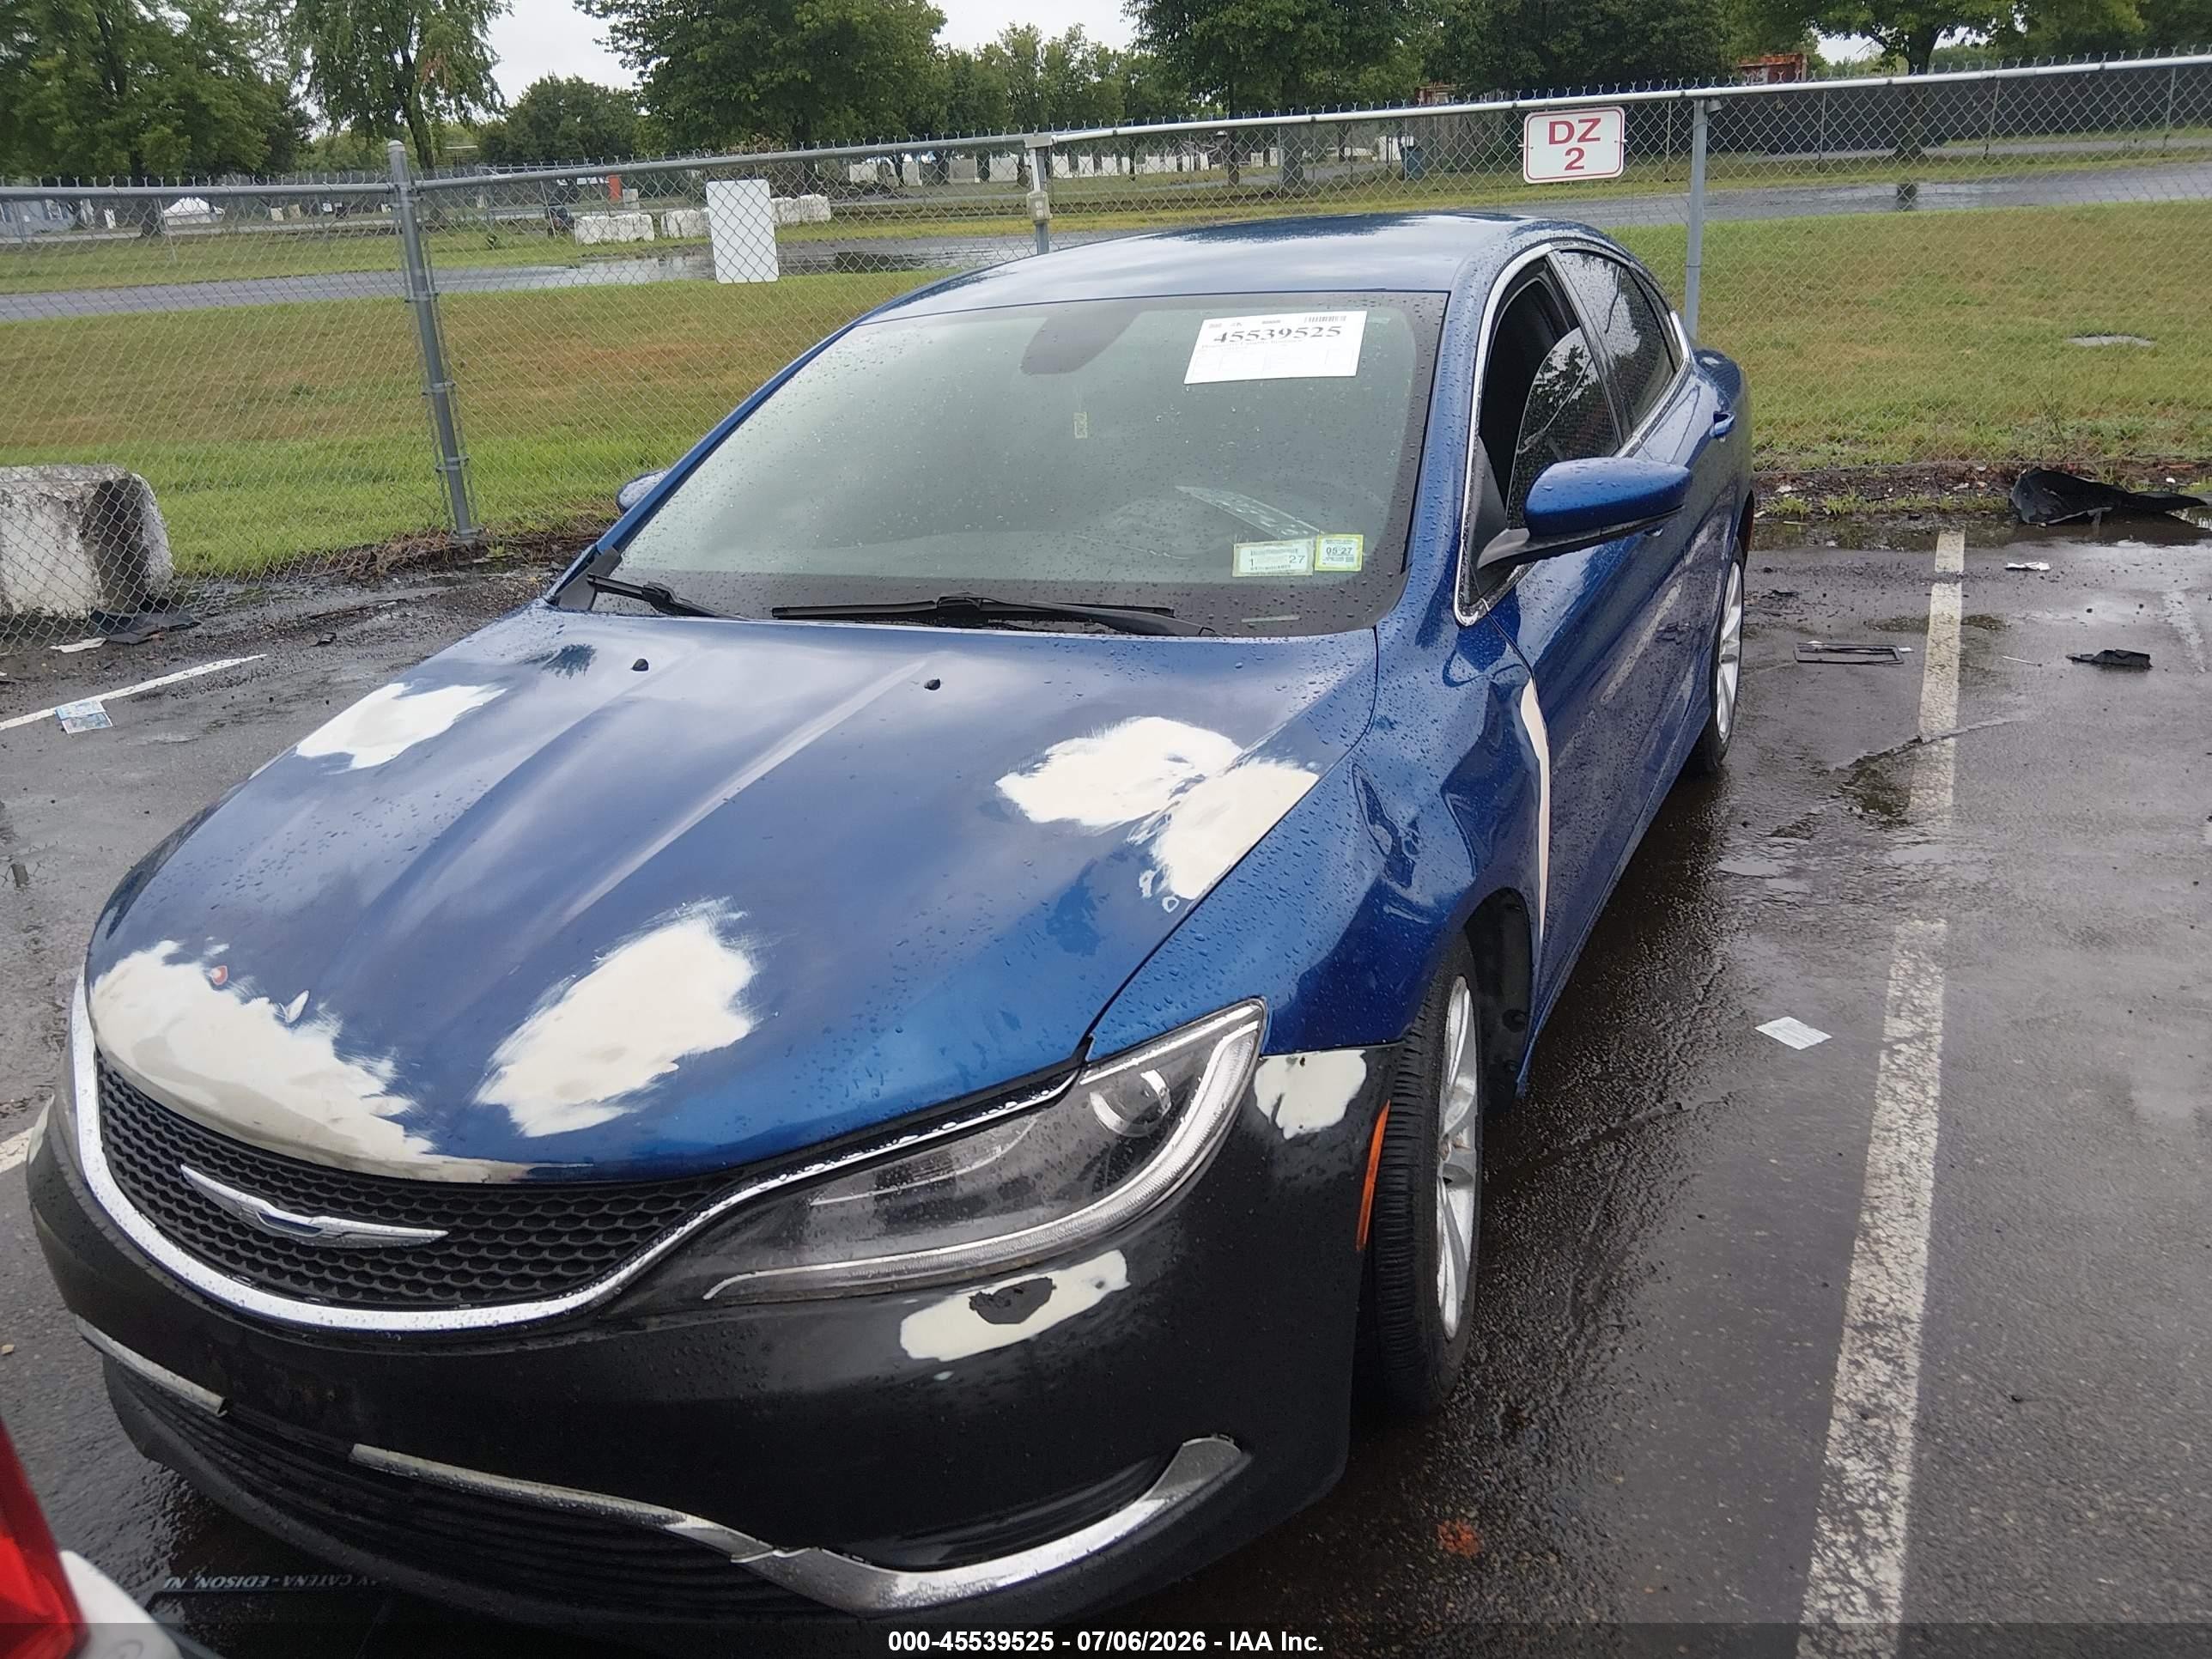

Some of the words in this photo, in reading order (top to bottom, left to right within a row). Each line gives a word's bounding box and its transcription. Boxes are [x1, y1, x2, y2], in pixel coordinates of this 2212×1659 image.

[1548, 118, 1601, 145] DZ
[1564, 147, 1585, 171] 2
[1212, 325, 1342, 343] 45539525
[162, 1576, 187, 1589] NJ
[283, 1574, 351, 1588] CATENA
